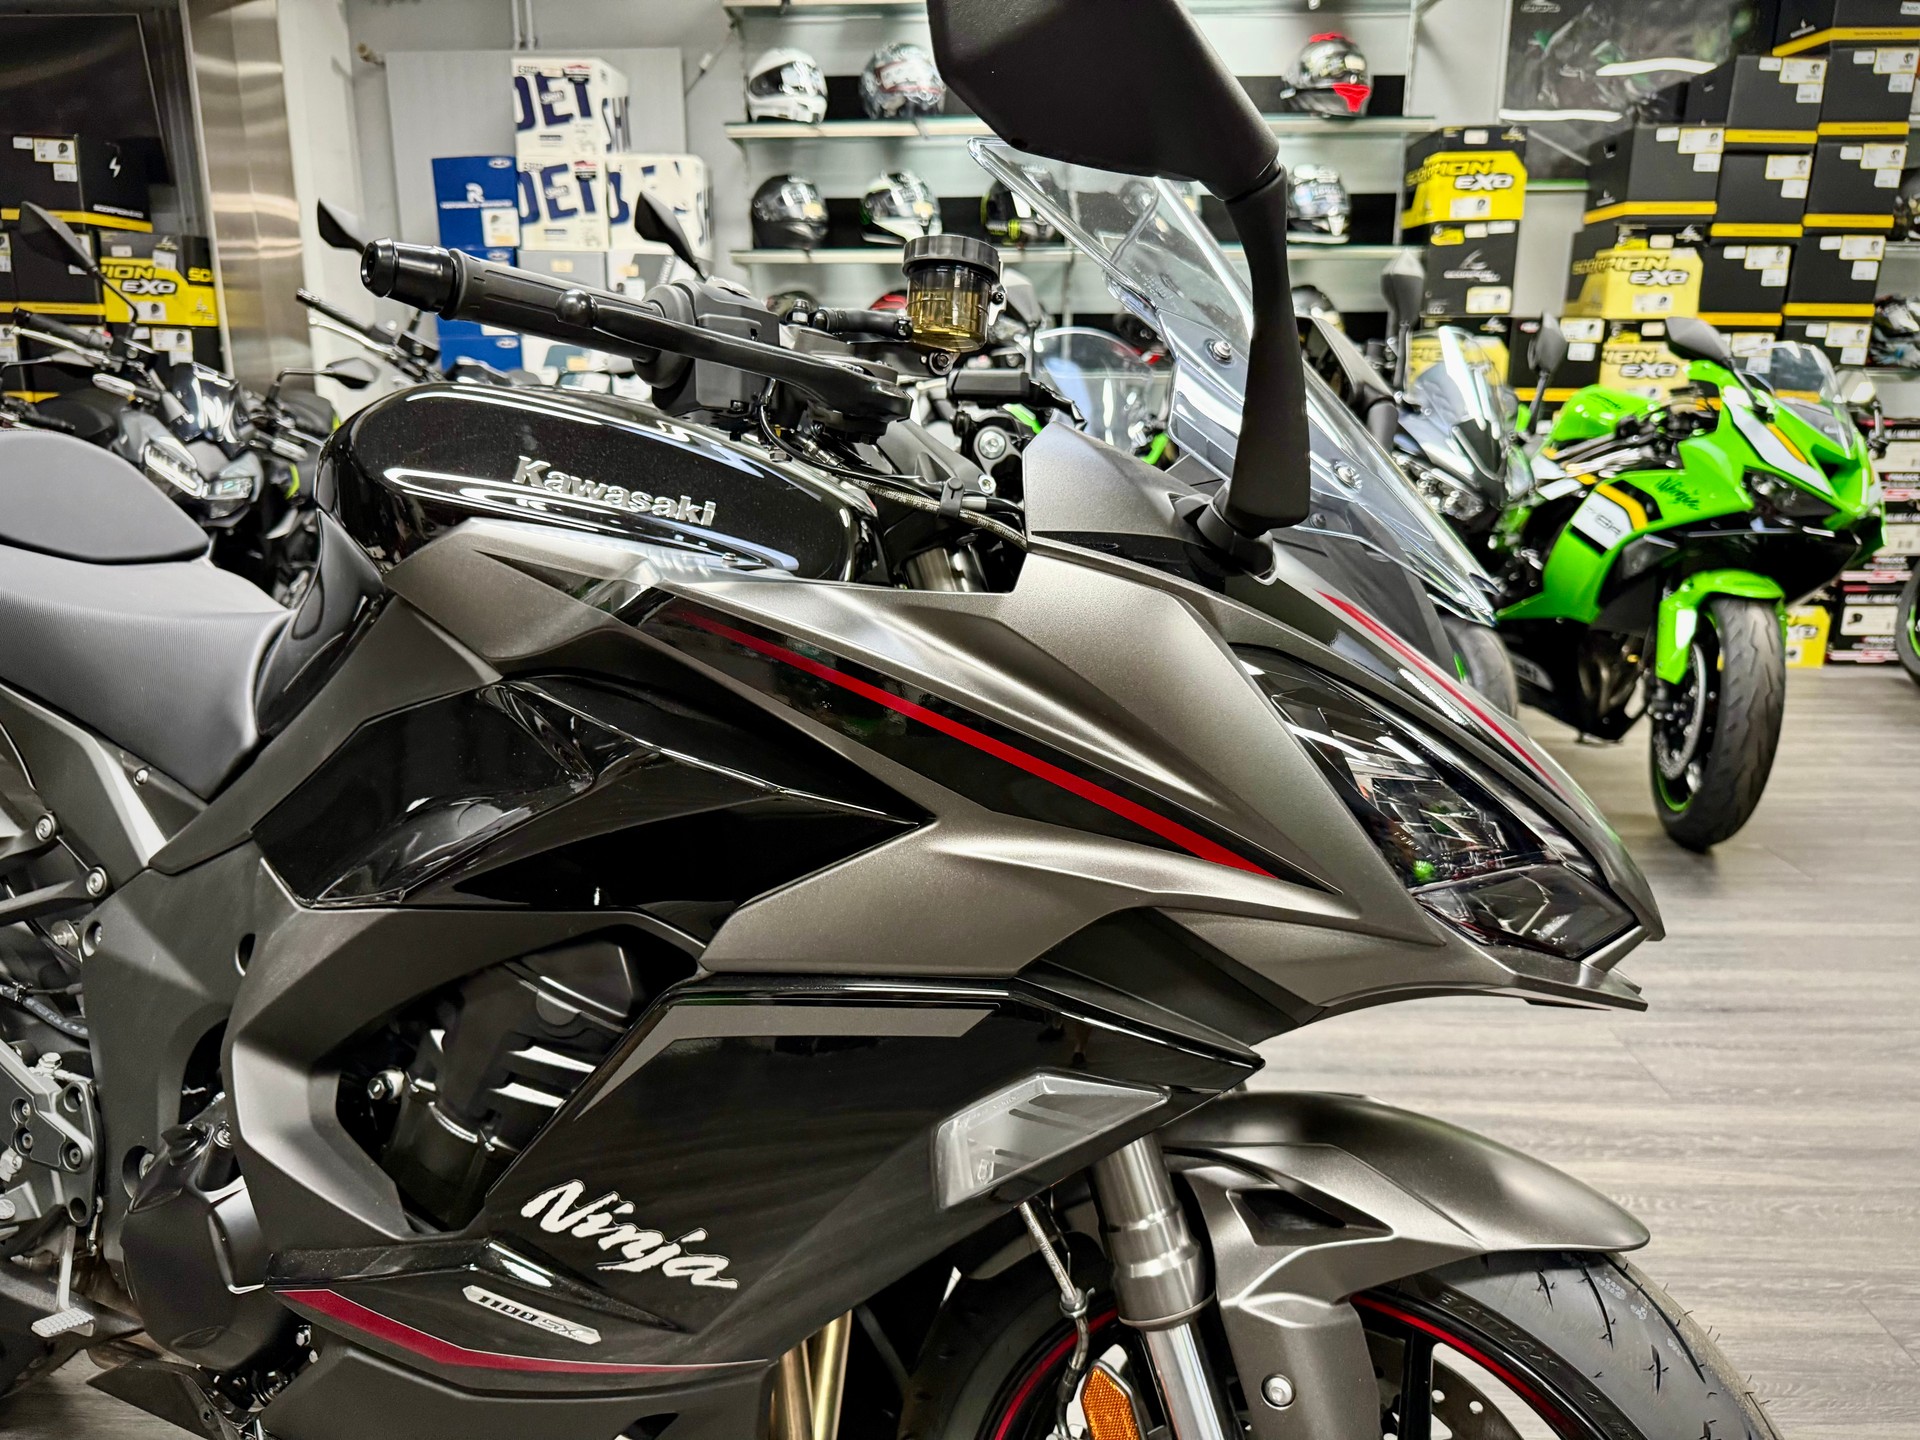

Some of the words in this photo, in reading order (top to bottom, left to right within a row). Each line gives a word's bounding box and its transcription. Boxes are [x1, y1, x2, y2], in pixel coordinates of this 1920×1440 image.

[1453, 172, 1515, 192] EXO
[121, 279, 177, 296] EXO
[1629, 269, 1690, 287] EXO
[1619, 362, 1679, 380] EXO
[512, 455, 717, 527] Kawasaki
[520, 1179, 739, 1289] Ninja
